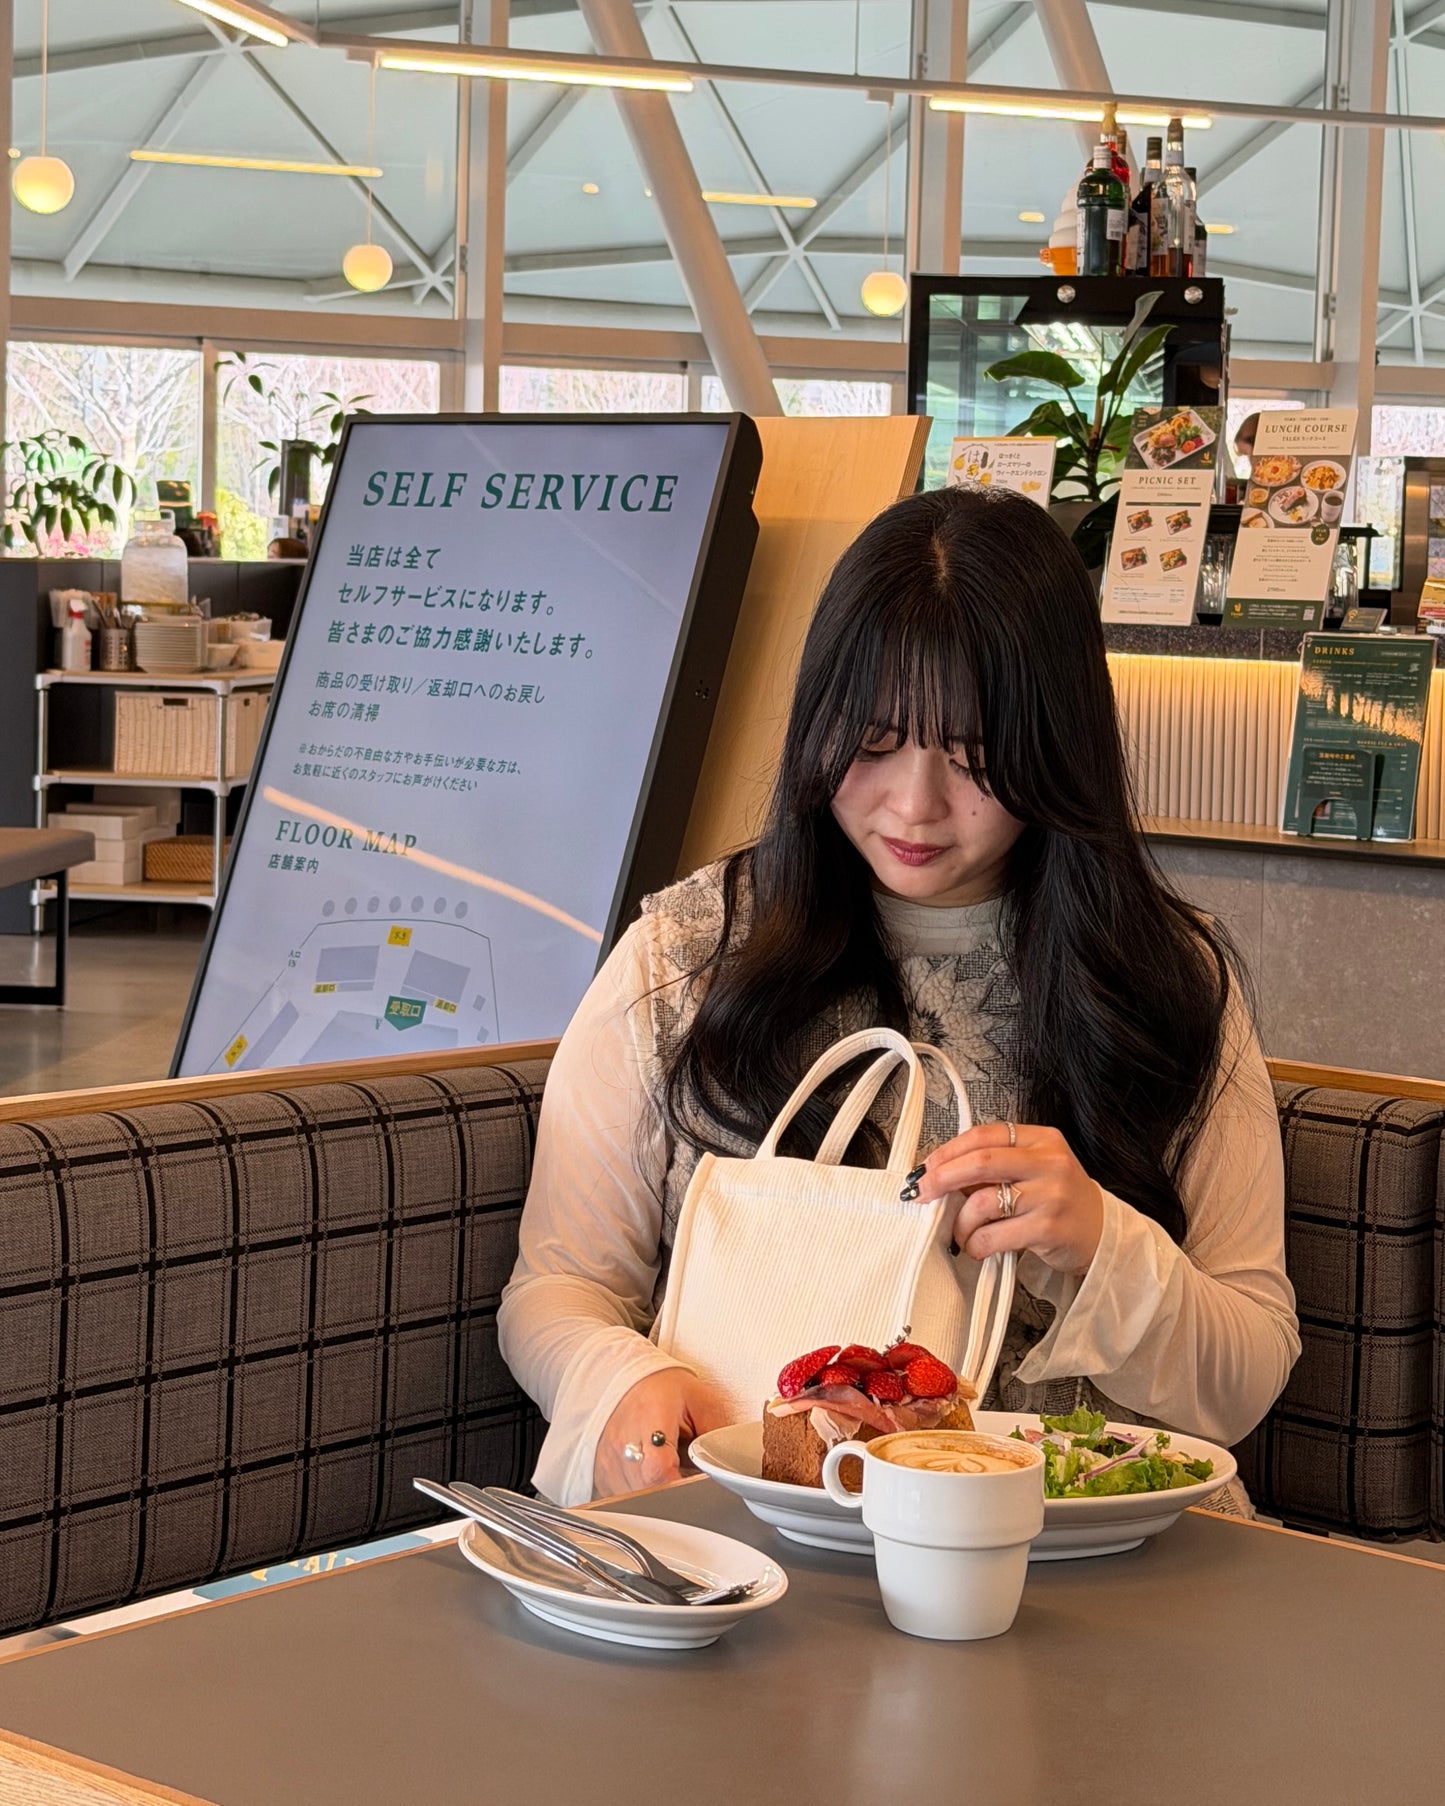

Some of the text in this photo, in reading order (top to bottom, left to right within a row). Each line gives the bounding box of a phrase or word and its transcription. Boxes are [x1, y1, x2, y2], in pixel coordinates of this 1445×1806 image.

[1265, 424, 1348, 433] LUNCH COURSE
[362, 470, 679, 513] SELF SERVICE
[1138, 476, 1197, 485] PICNIC SET
[346, 544, 442, 570] 当店は全て
[338, 583, 555, 616] セルフサービスになります。
[327, 620, 594, 660] 皆さまのご協力感謝いたします。
[1313, 646, 1356, 656] DRINKS
[308, 700, 381, 723] お席の清掃
[292, 762, 479, 792] お気軽に近くのスタッフにお声がけください
[275, 820, 417, 857] FLOOR MAP
[267, 853, 320, 875] 店舗案内
